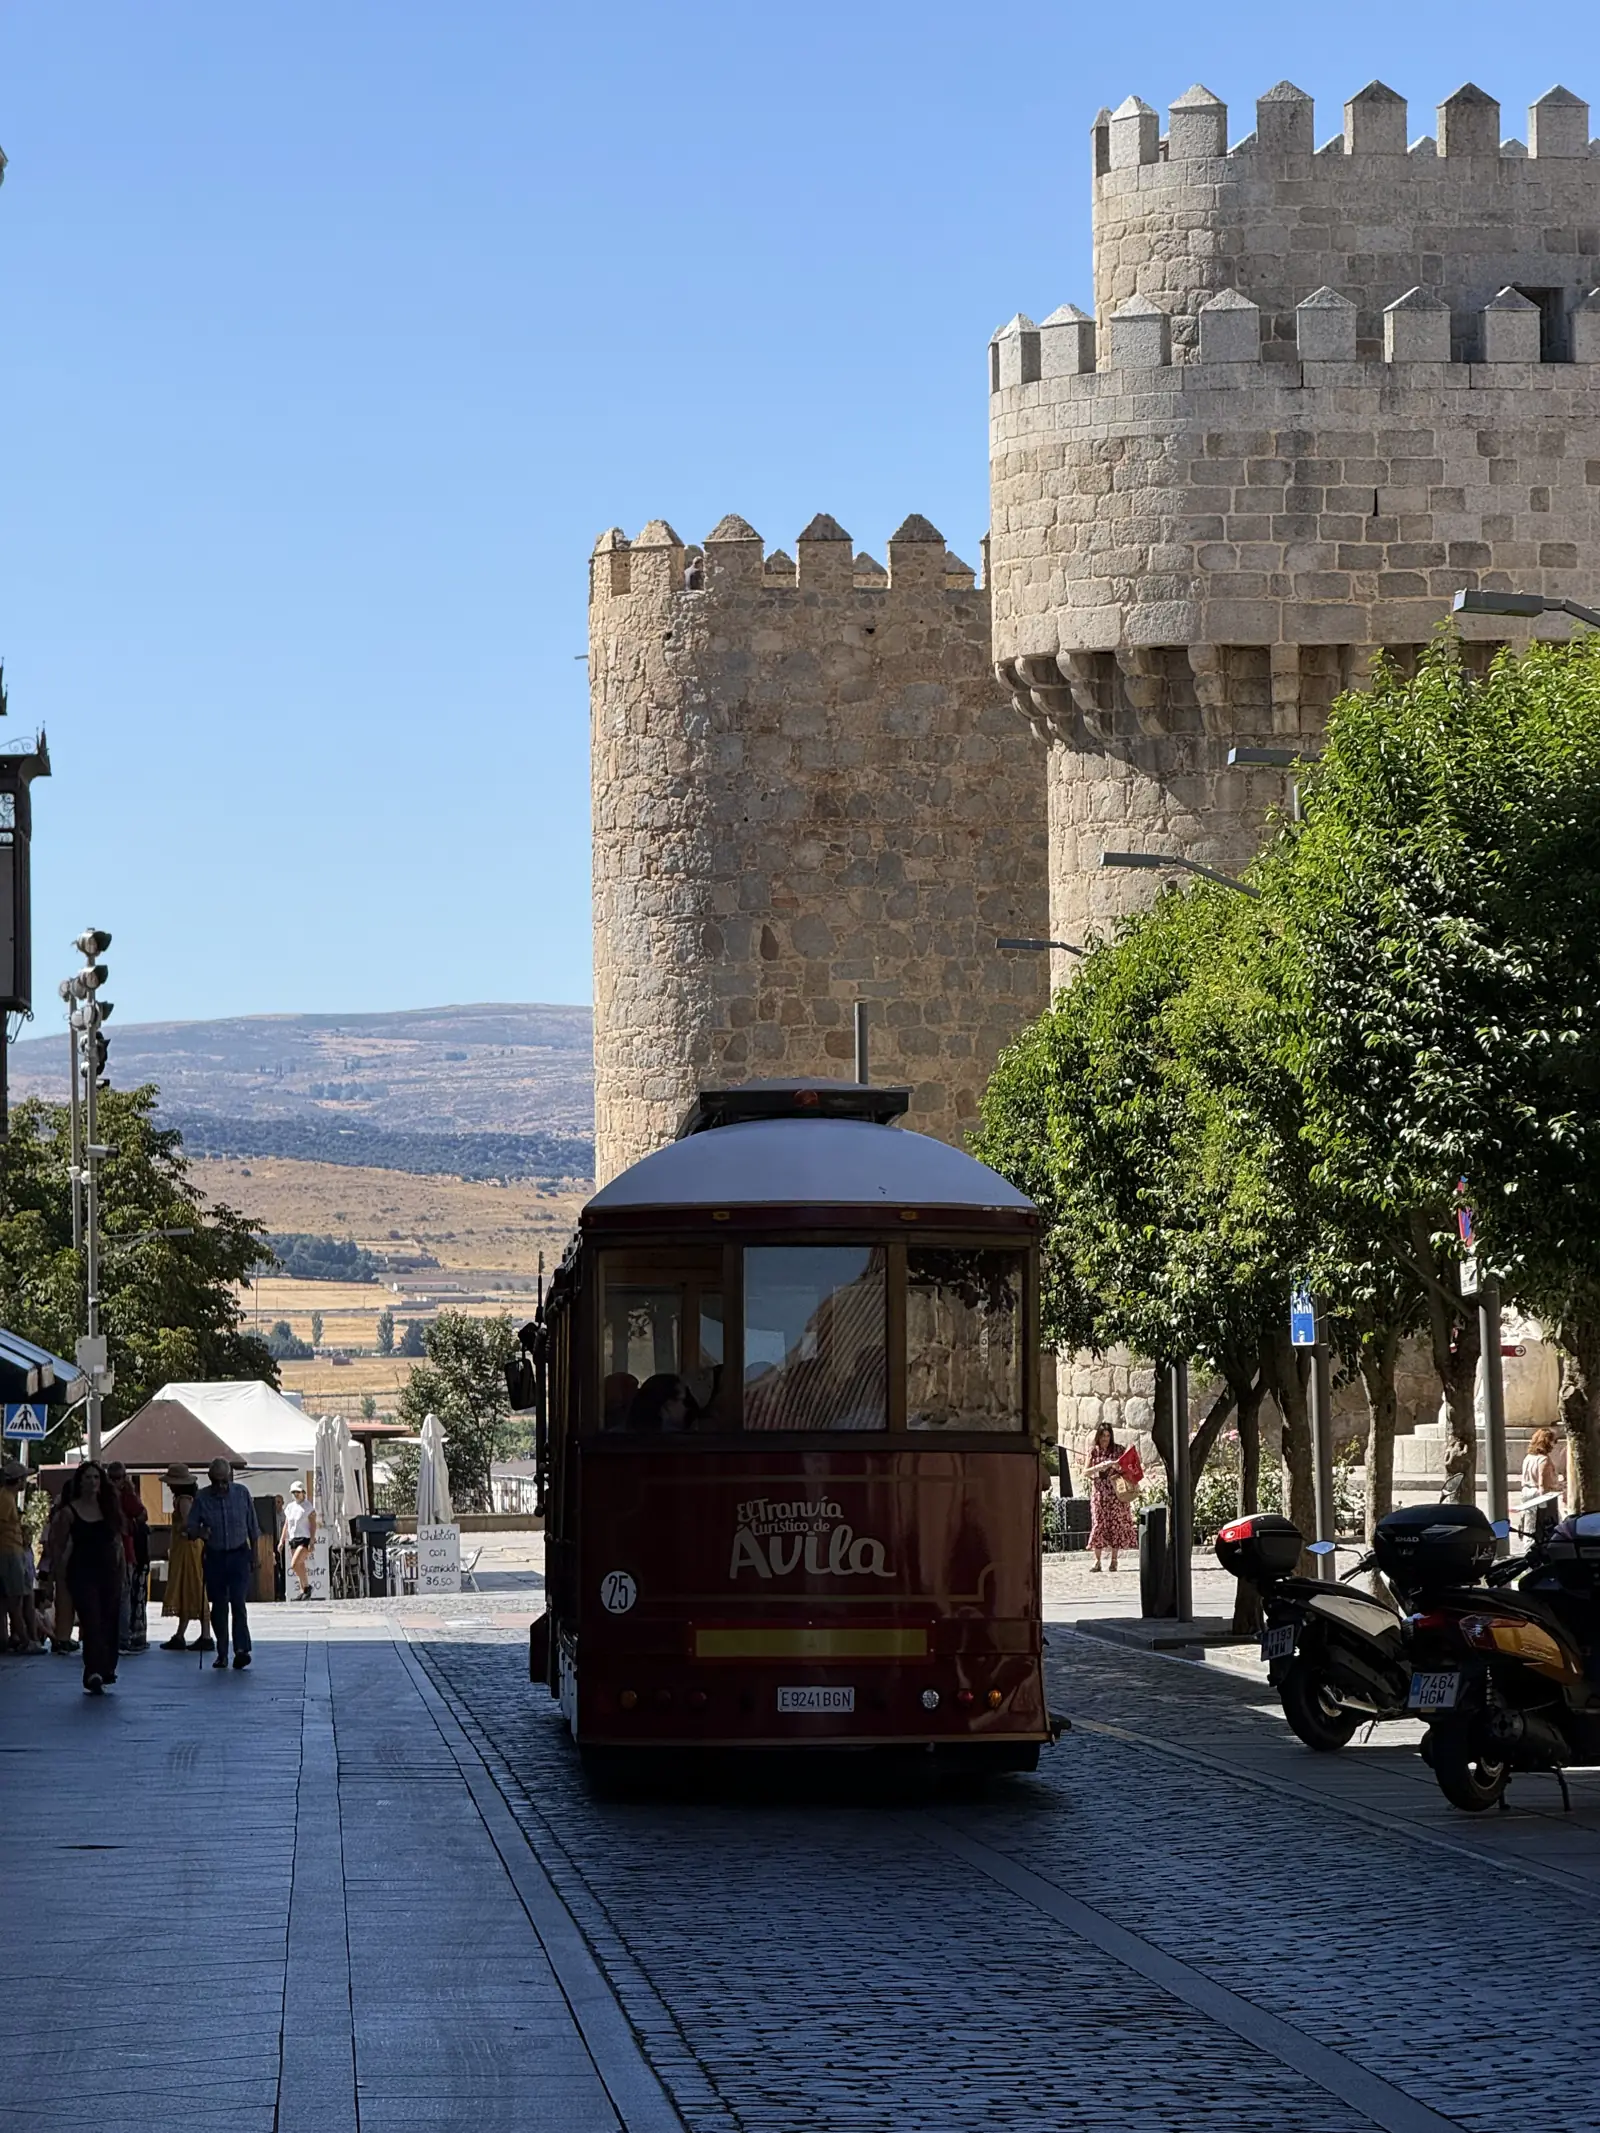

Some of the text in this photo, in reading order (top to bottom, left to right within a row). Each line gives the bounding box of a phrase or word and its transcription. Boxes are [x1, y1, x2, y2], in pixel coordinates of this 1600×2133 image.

[737, 1496, 844, 1522] El Tranvía
[751, 1519, 830, 1536] turístico de
[429, 1549, 446, 1557] con
[608, 1575, 628, 1609] 25
[1421, 1675, 1454, 1689] 7464
